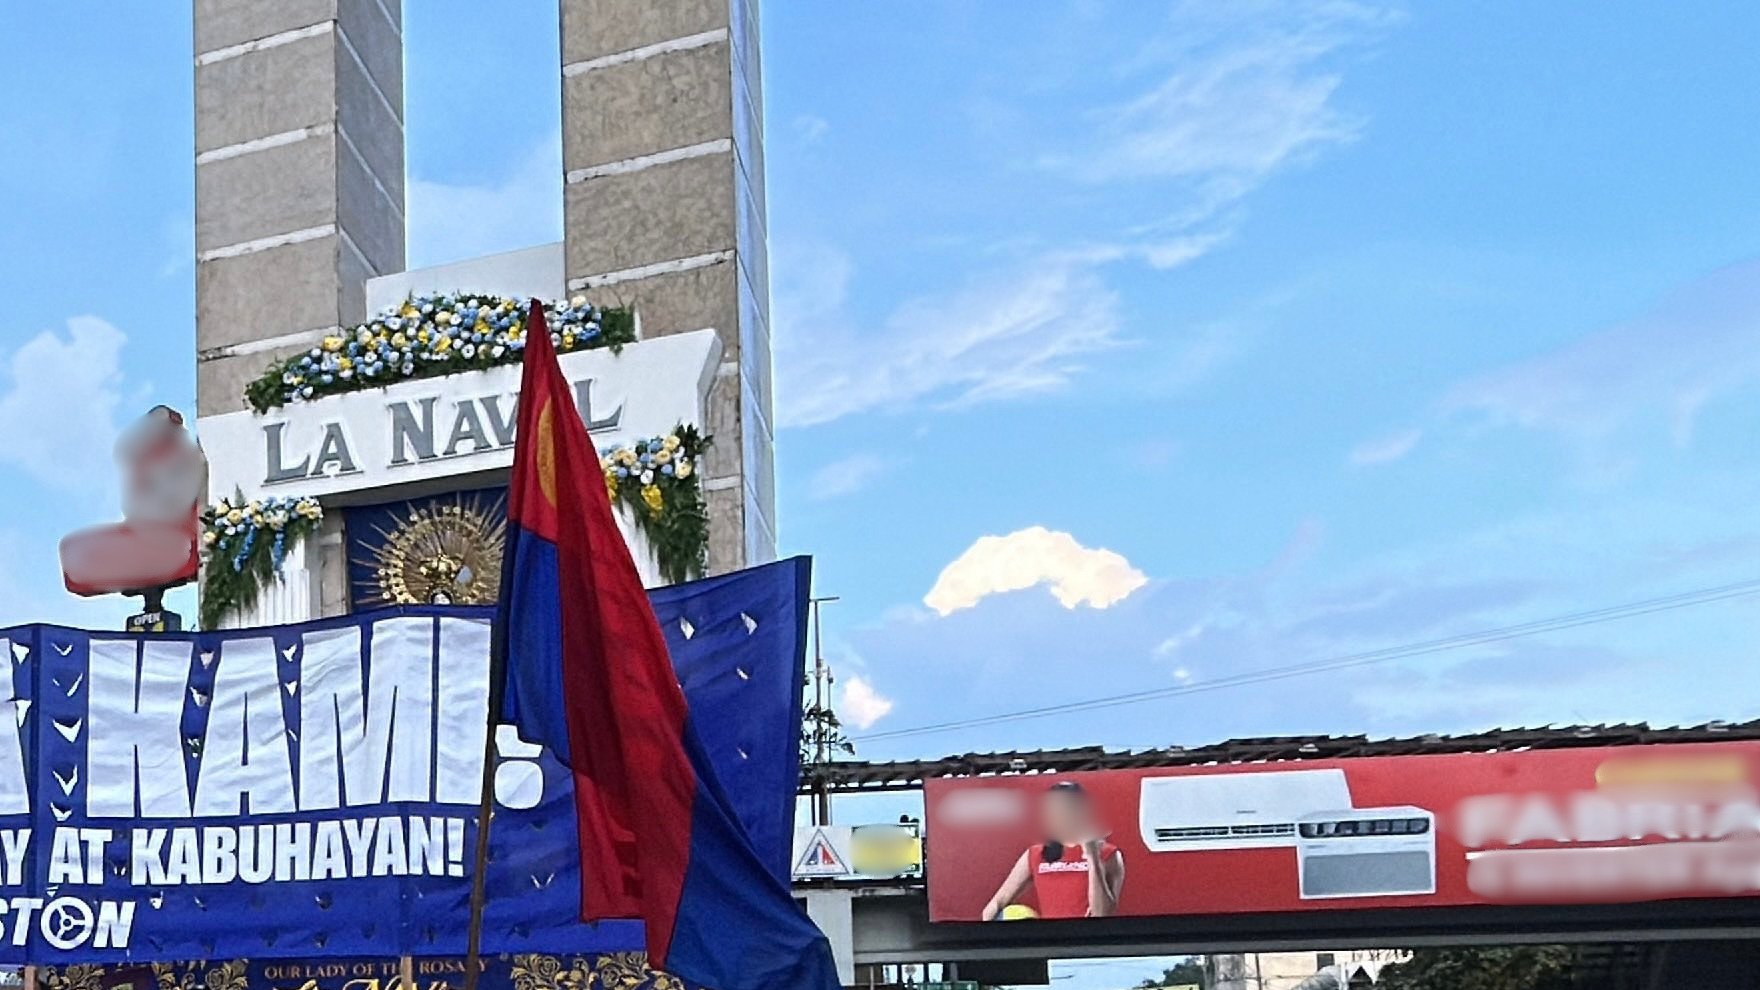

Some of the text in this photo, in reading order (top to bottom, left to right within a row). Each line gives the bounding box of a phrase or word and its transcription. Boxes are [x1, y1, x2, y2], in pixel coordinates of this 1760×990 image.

[263, 377, 623, 486] LA NAVL
[47, 825, 114, 886] AT
[130, 816, 466, 887] KABUHAYAN!
[264, 964, 301, 980] OUR
[305, 962, 348, 978] LADY
[352, 962, 374, 976] OF
[418, 958, 490, 973] ROSAY
